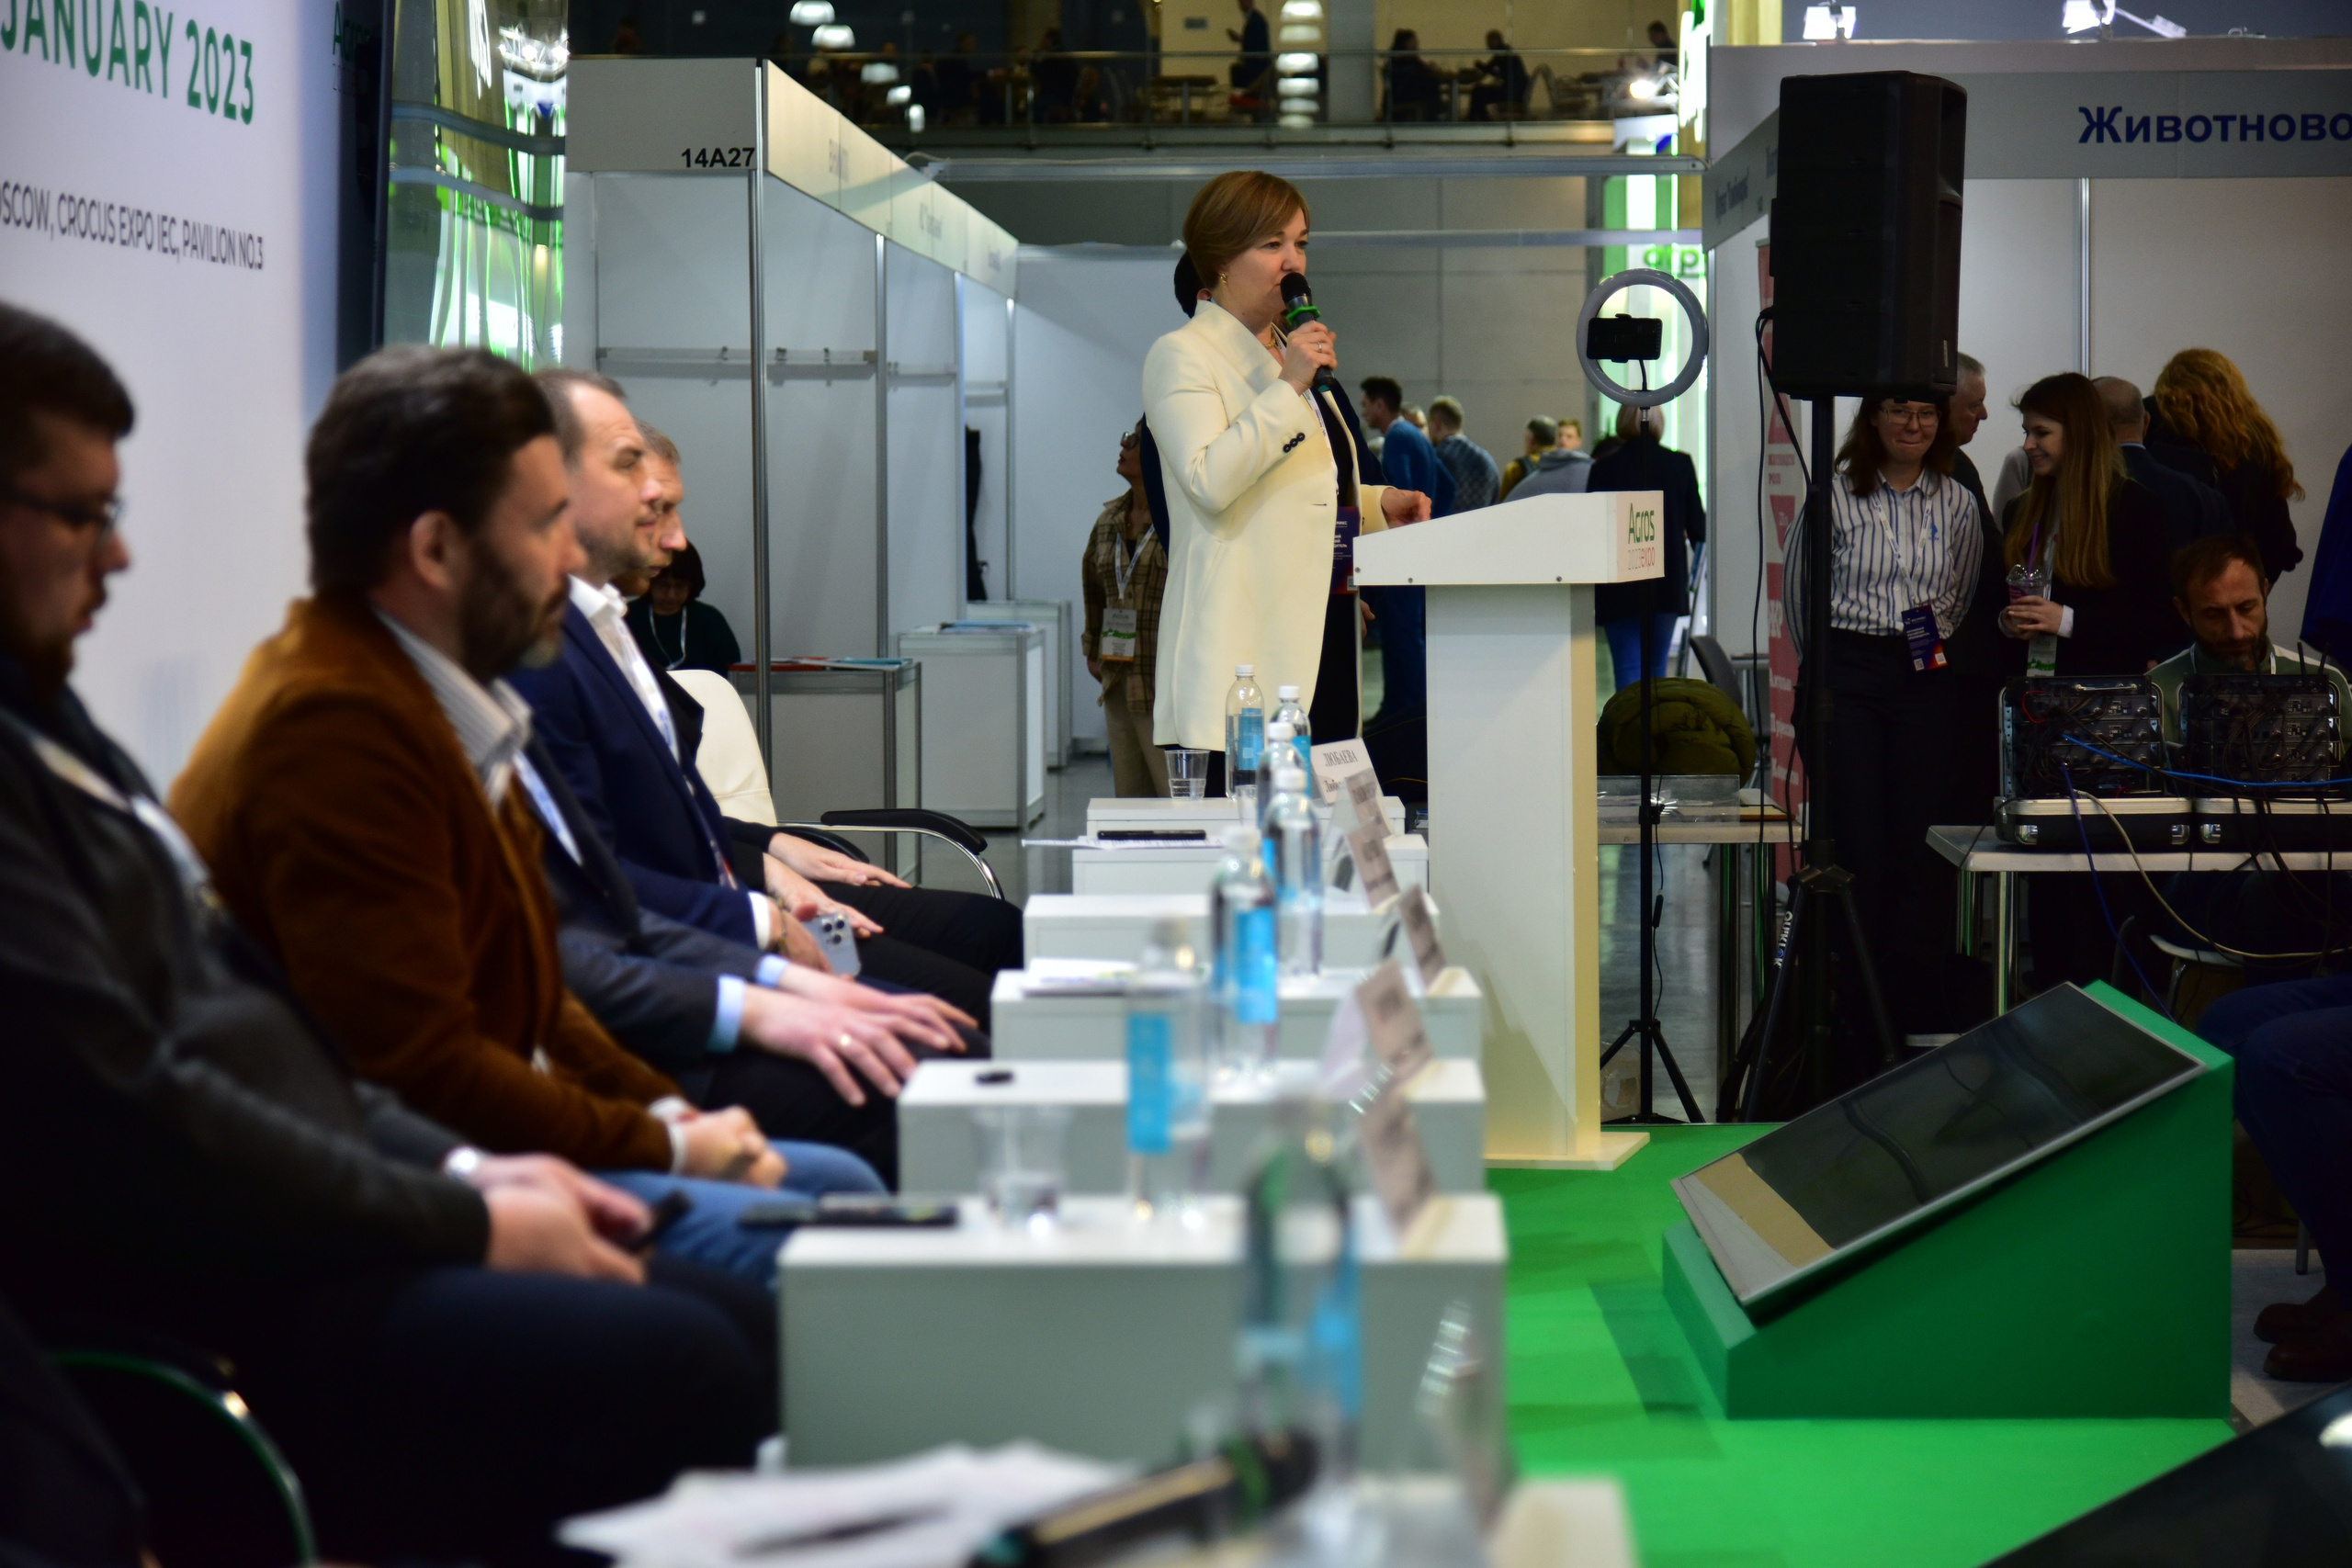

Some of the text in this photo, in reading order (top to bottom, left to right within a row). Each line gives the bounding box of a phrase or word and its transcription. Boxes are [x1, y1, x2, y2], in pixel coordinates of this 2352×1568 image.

[186, 19, 254, 125] 2023
[2078, 107, 2352, 143] Животново
[682, 147, 755, 167] 14A27
[0, 180, 264, 270] SCOW, CROCUS EXPO IEC, PAVILION NO.3
[1628, 502, 1656, 545] Agros
[1323, 750, 1359, 767] ЛЮБАЕВА
